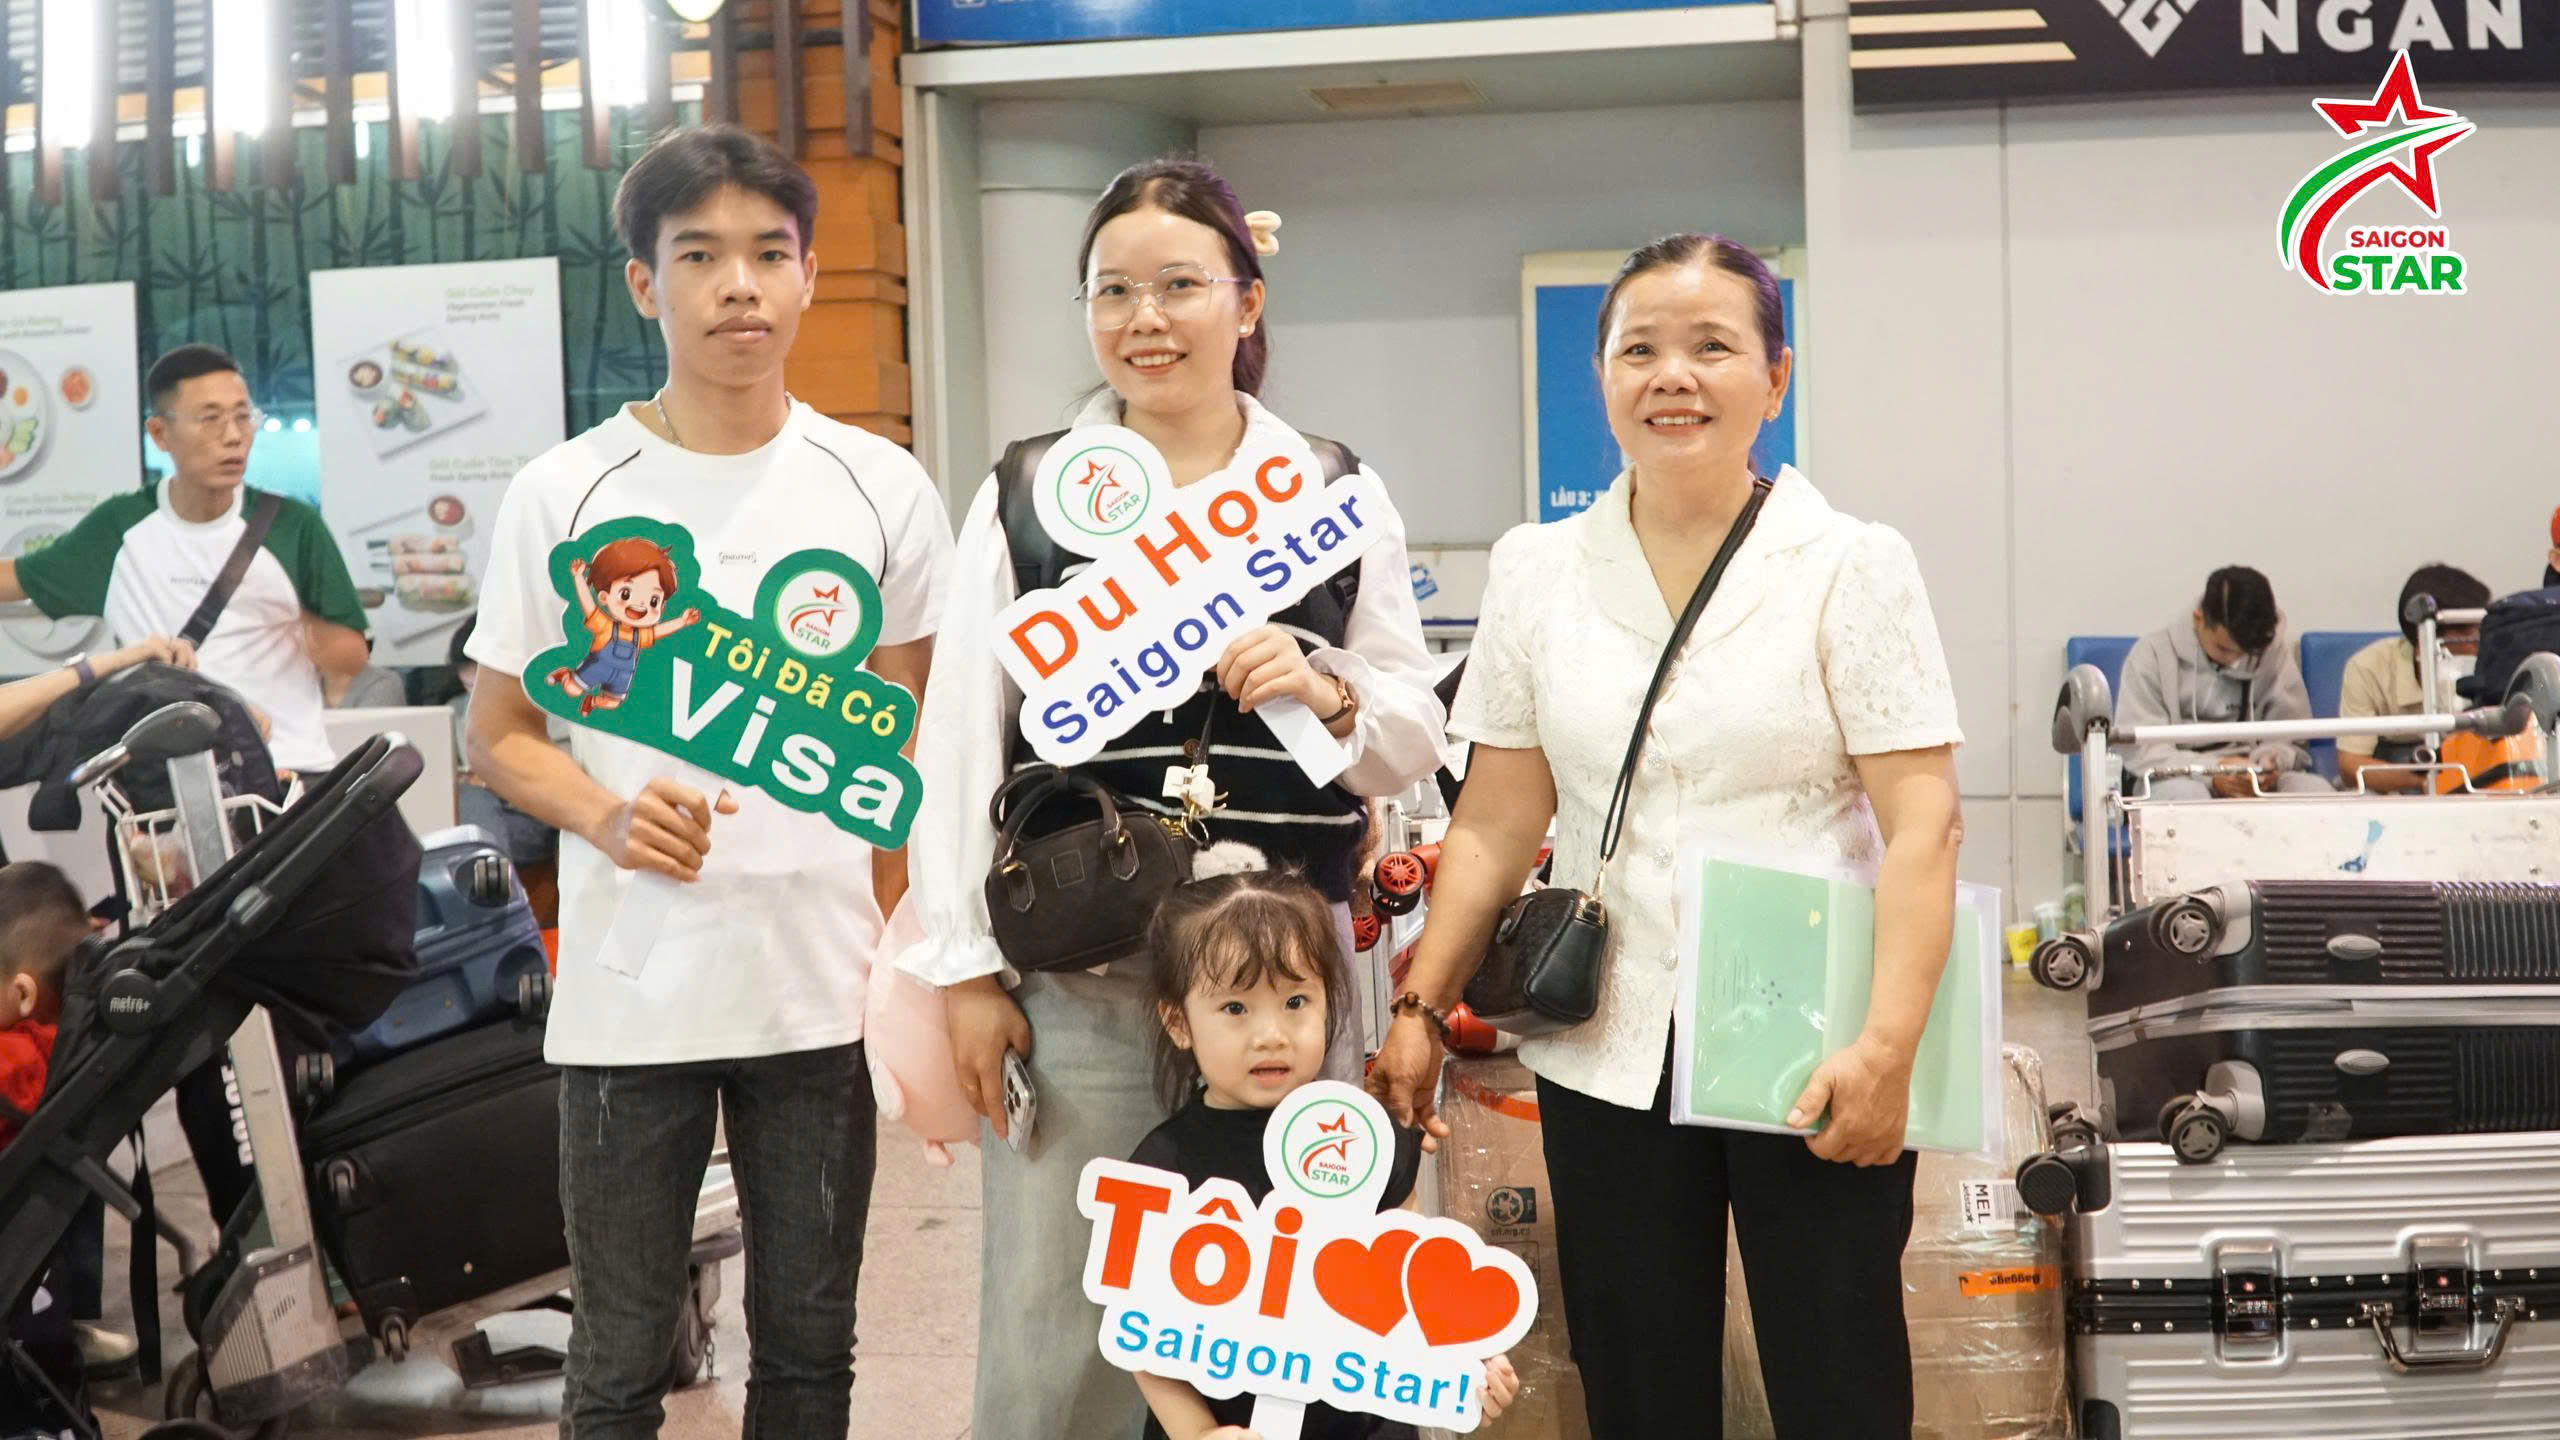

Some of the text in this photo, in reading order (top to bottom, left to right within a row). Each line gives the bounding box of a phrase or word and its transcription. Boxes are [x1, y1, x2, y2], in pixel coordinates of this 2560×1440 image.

[1108, 494, 1141, 521] STAR
[1009, 456, 1303, 679] Du Học
[797, 627, 832, 650] STAR
[1043, 496, 1364, 744] Saigon Star
[706, 623, 897, 737] Tôi Đã Có
[671, 656, 904, 832] Visa
[1311, 1169, 1350, 1185] STAR
[1319, 1161, 1347, 1172] SAIGON
[1975, 1184, 1991, 1224] MEL
[1095, 1176, 1303, 1319] Tôi
[1989, 1272, 2040, 1285] Baggage
[1116, 1311, 1470, 1414] Saigon Star!
